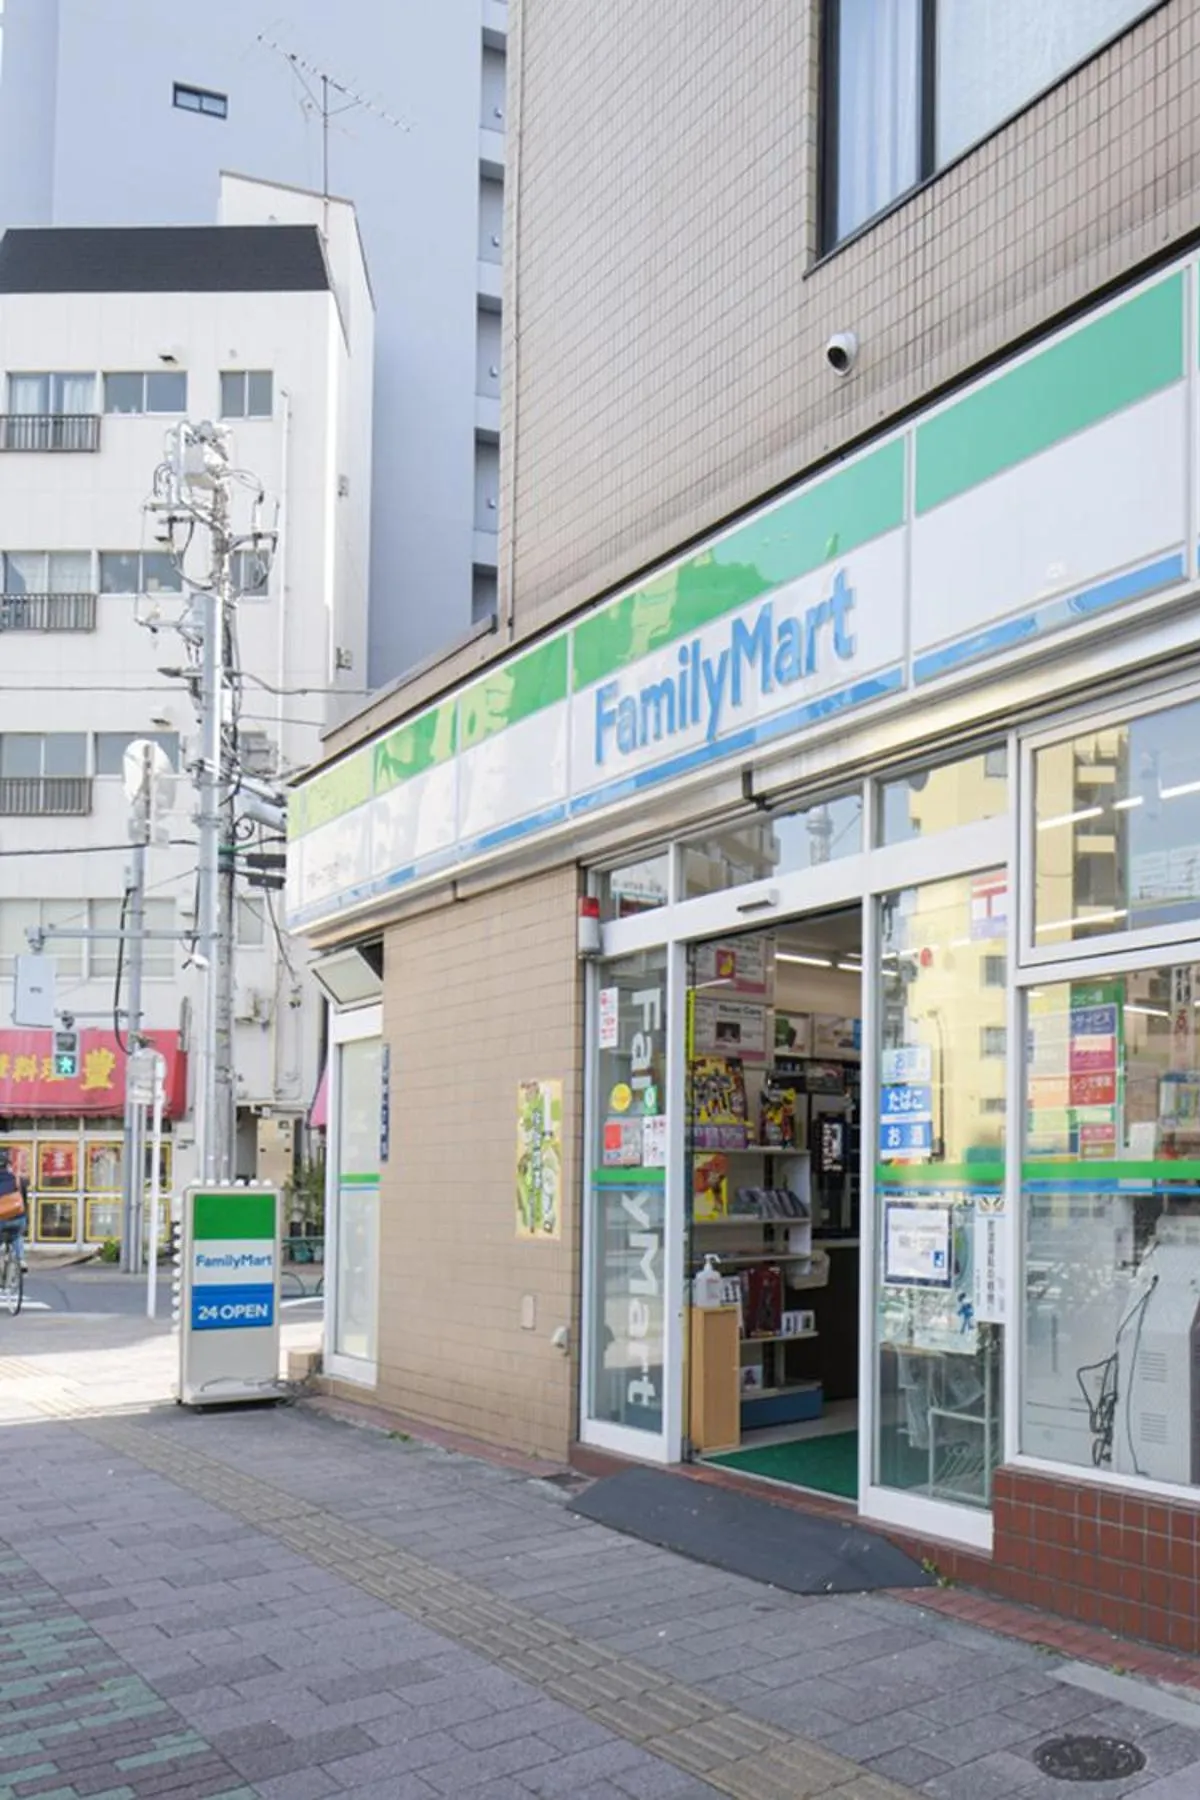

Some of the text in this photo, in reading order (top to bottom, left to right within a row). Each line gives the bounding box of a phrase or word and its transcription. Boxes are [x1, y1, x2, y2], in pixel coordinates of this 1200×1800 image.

[594, 567, 856, 765] FamilyMart
[196, 1254, 272, 1270] FamilyMart
[198, 1303, 268, 1321] 24 OPEN
